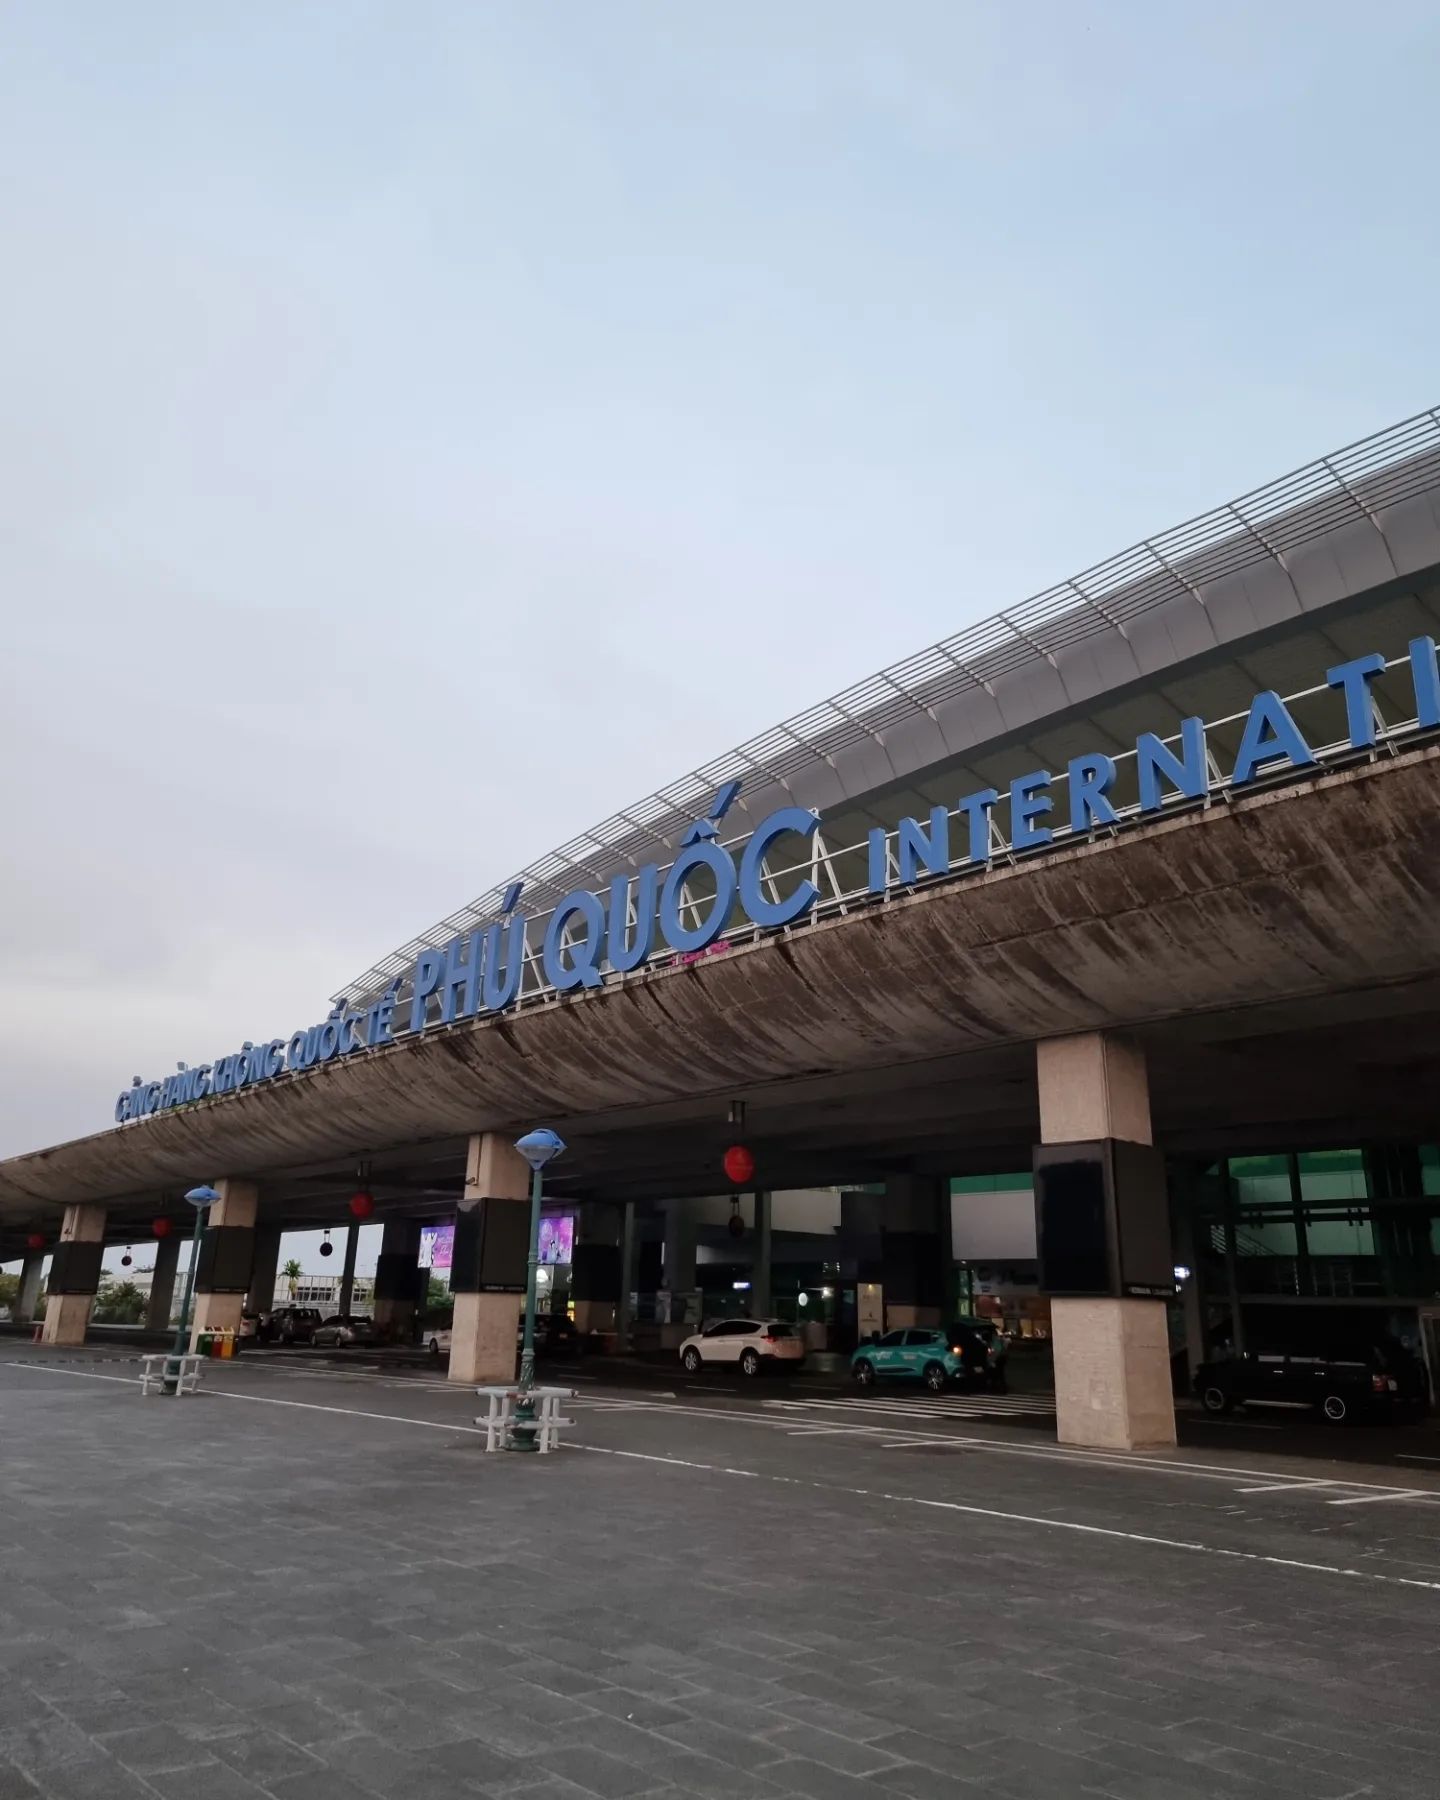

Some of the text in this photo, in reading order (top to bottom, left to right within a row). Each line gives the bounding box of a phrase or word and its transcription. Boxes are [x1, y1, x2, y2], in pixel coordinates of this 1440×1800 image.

[157, 1062, 211, 1109] HÀNG
[209, 1039, 285, 1094] KHÔNG
[287, 998, 362, 1070] QUỐC
[367, 977, 403, 1046] TẾ
[410, 881, 526, 1032] PHÚ
[543, 780, 822, 990] QUỐC
[868, 635, 1440, 895] INTERNATI
